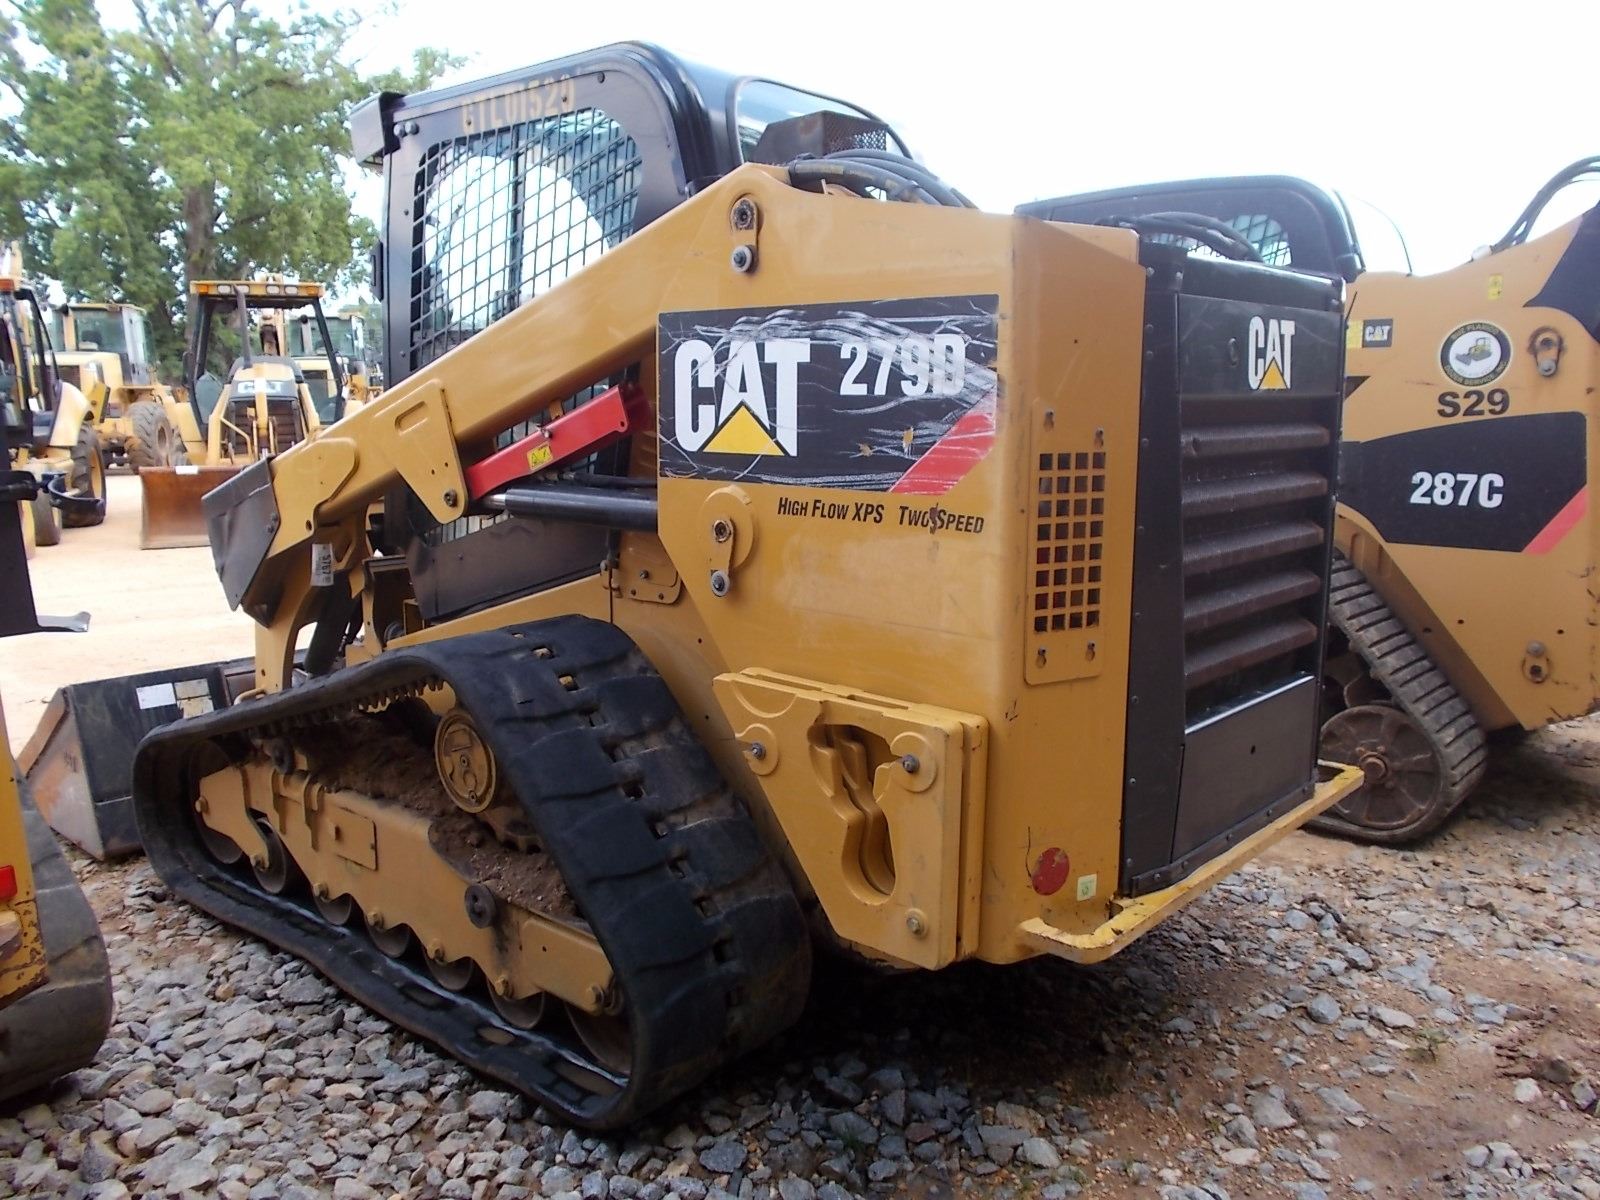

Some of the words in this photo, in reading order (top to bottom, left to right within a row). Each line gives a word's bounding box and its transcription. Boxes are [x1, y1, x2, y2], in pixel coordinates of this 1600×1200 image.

[1365, 325, 1391, 342] CAT
[1248, 316, 1295, 389] CAT
[674, 337, 811, 457] CAT
[839, 333, 967, 397] 279D
[1437, 388, 1510, 417] S29
[1410, 471, 1504, 508] 287C
[852, 501, 885, 524] XPS
